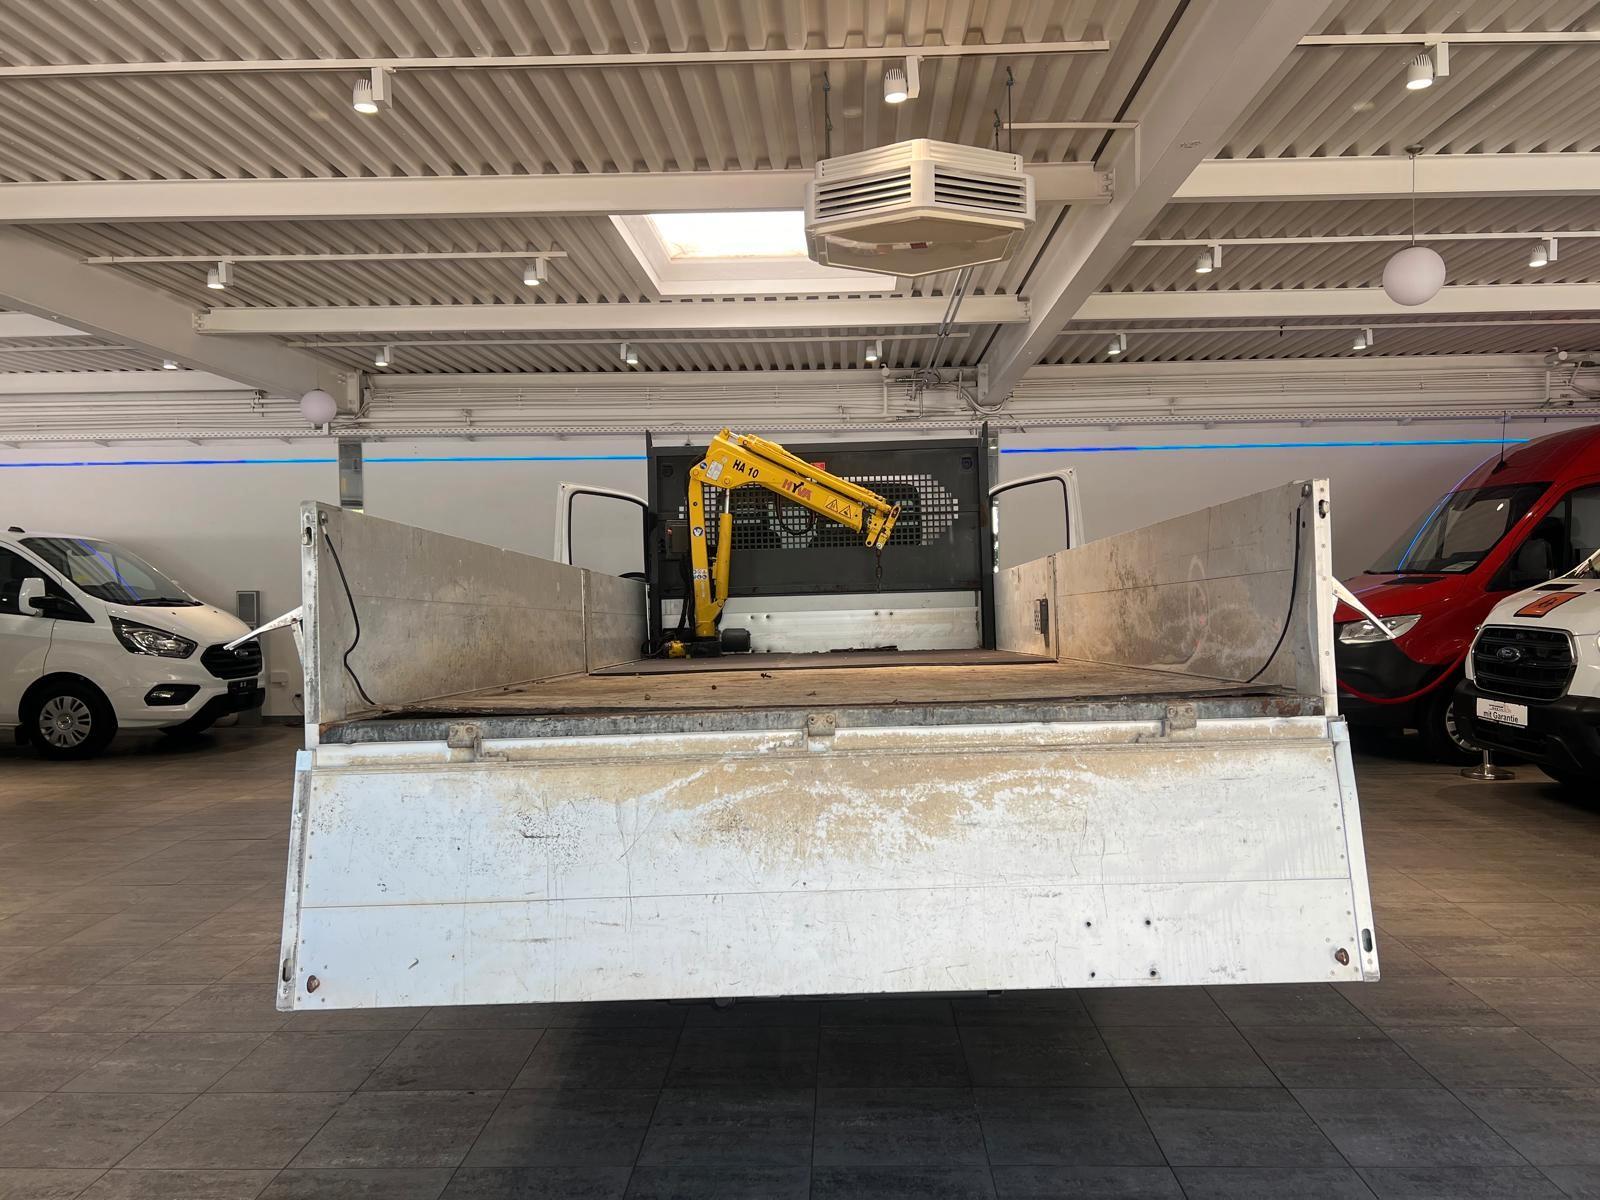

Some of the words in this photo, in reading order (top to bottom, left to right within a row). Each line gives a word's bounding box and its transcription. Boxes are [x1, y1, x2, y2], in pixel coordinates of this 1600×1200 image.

[732, 459, 746, 473] HA
[748, 467, 759, 479] 10
[782, 478, 812, 501] HYVA
[1492, 711, 1519, 723] Garantie
